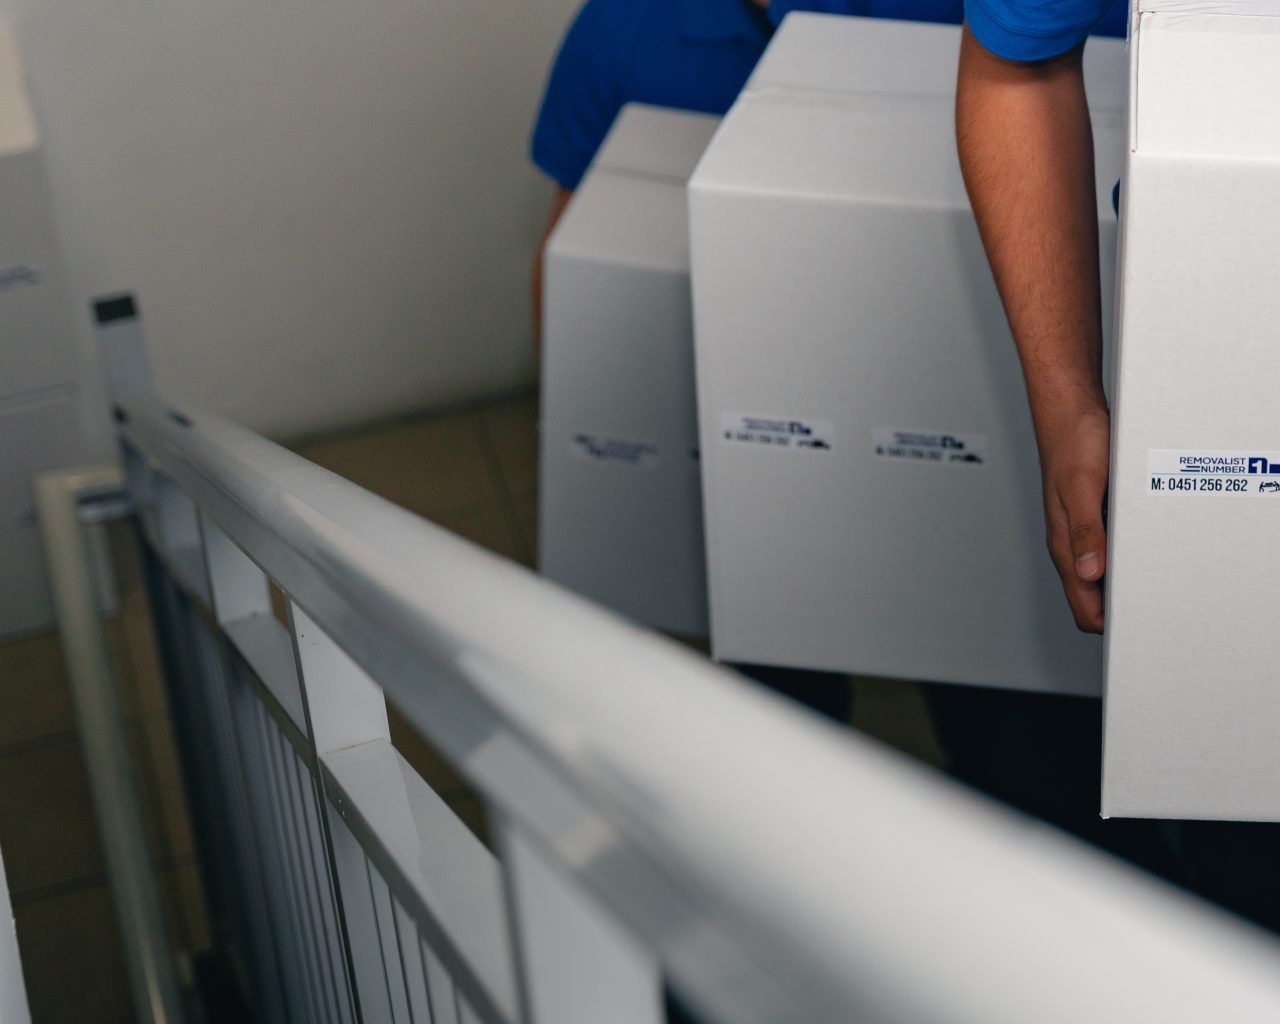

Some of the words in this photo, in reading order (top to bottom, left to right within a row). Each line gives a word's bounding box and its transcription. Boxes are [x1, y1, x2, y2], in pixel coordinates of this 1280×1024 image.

[1179, 457, 1246, 465] REMOVALIST
[1201, 466, 1246, 474] NUMBER
[1151, 478, 1165, 491] M:
[1168, 478, 1197, 491] 0451
[1200, 479, 1223, 492] 256
[1225, 480, 1248, 492] 262
